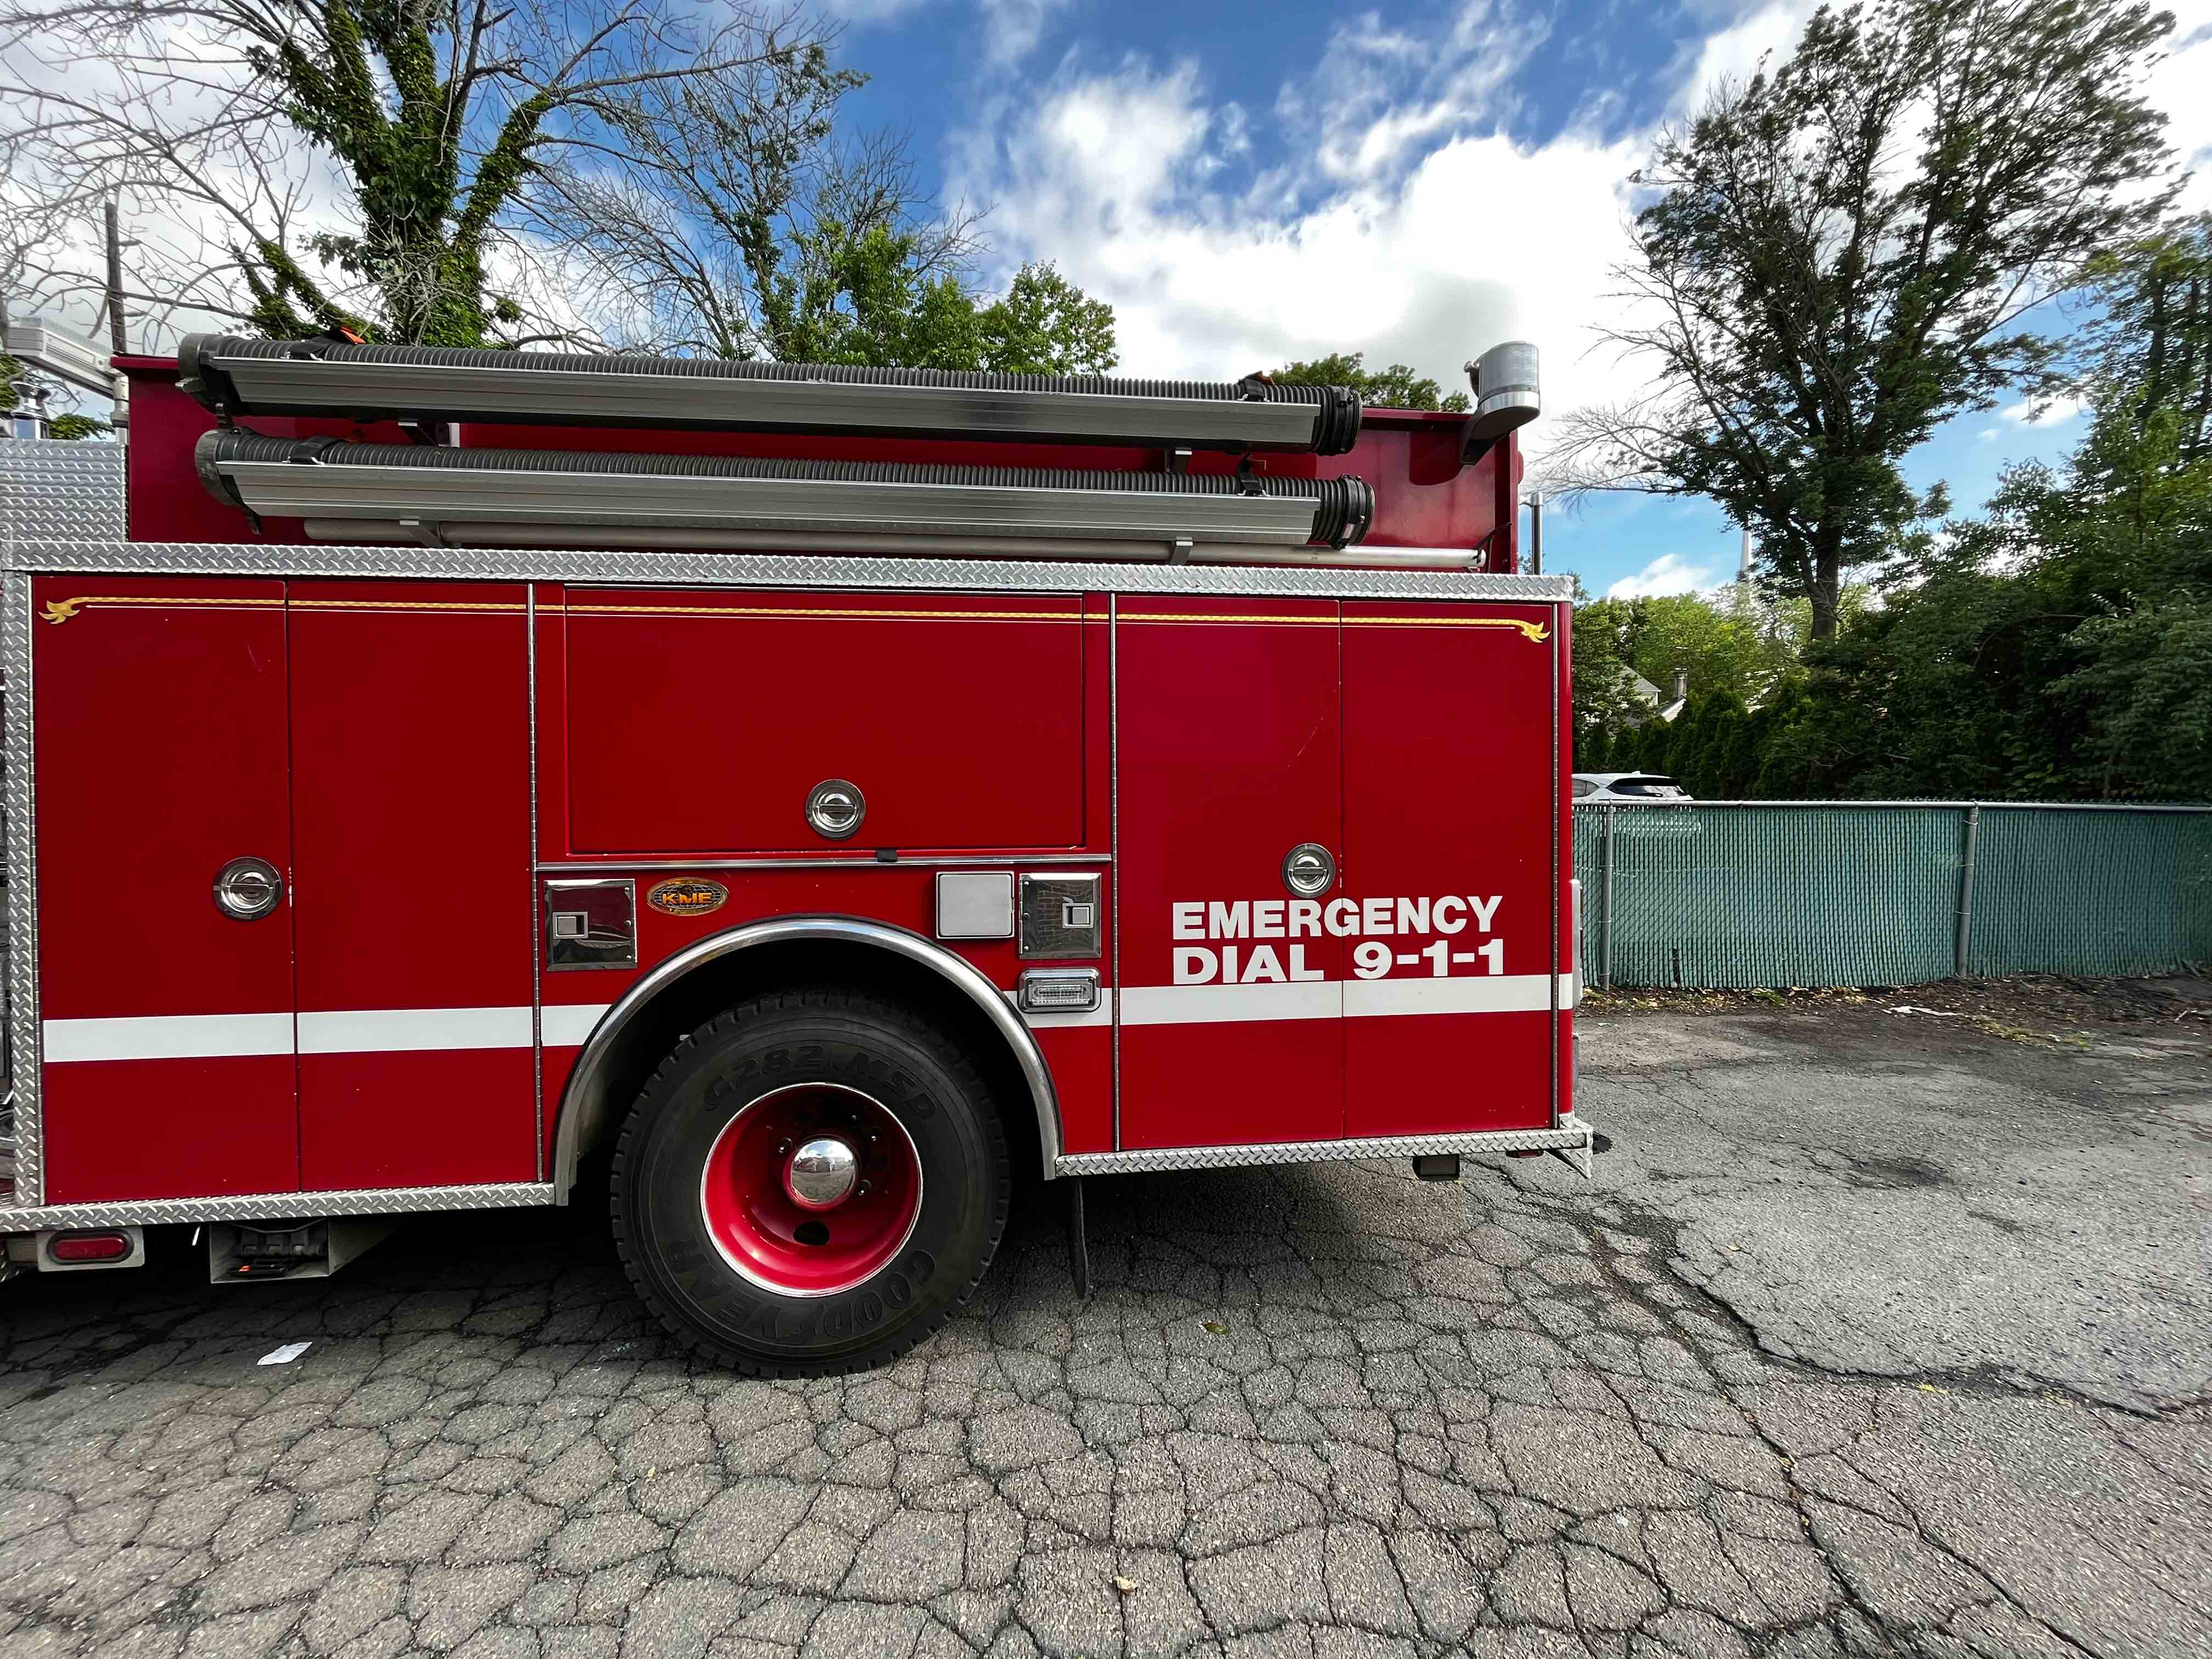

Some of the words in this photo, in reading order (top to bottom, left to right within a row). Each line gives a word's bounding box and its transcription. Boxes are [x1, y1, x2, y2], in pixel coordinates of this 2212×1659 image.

[662, 891, 713, 905] KME
[1172, 895, 1504, 940] EMERGENCY
[1172, 944, 1324, 985] DIAL
[1352, 938, 1504, 980] 9-1-1
